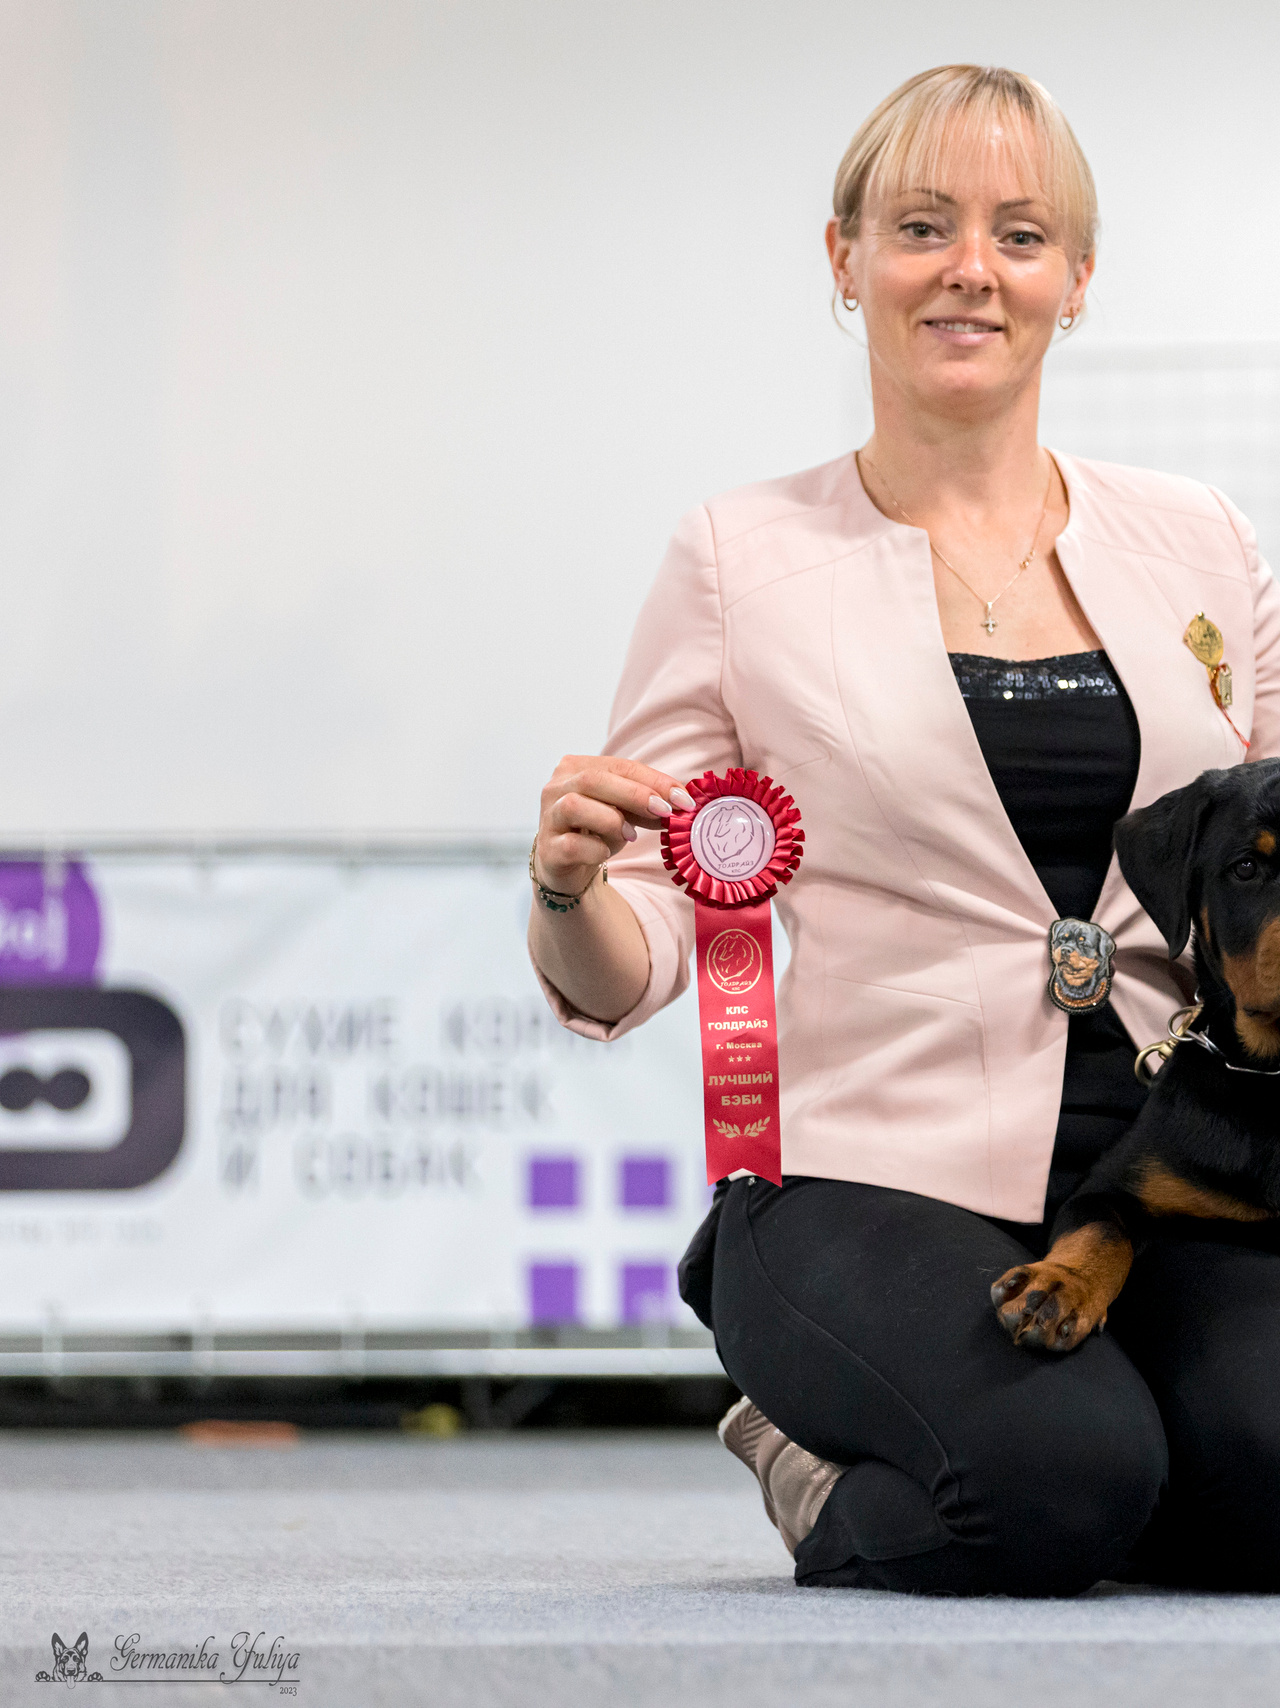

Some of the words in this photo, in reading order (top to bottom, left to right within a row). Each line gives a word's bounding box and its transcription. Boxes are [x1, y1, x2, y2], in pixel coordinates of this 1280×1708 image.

[726, 1006, 749, 1014] КЛС
[708, 1018, 768, 1031] ГОЛДРАЙЗ
[708, 1071, 773, 1086] ЛУЧШИЙ
[721, 1094, 762, 1106] БЭБИ
